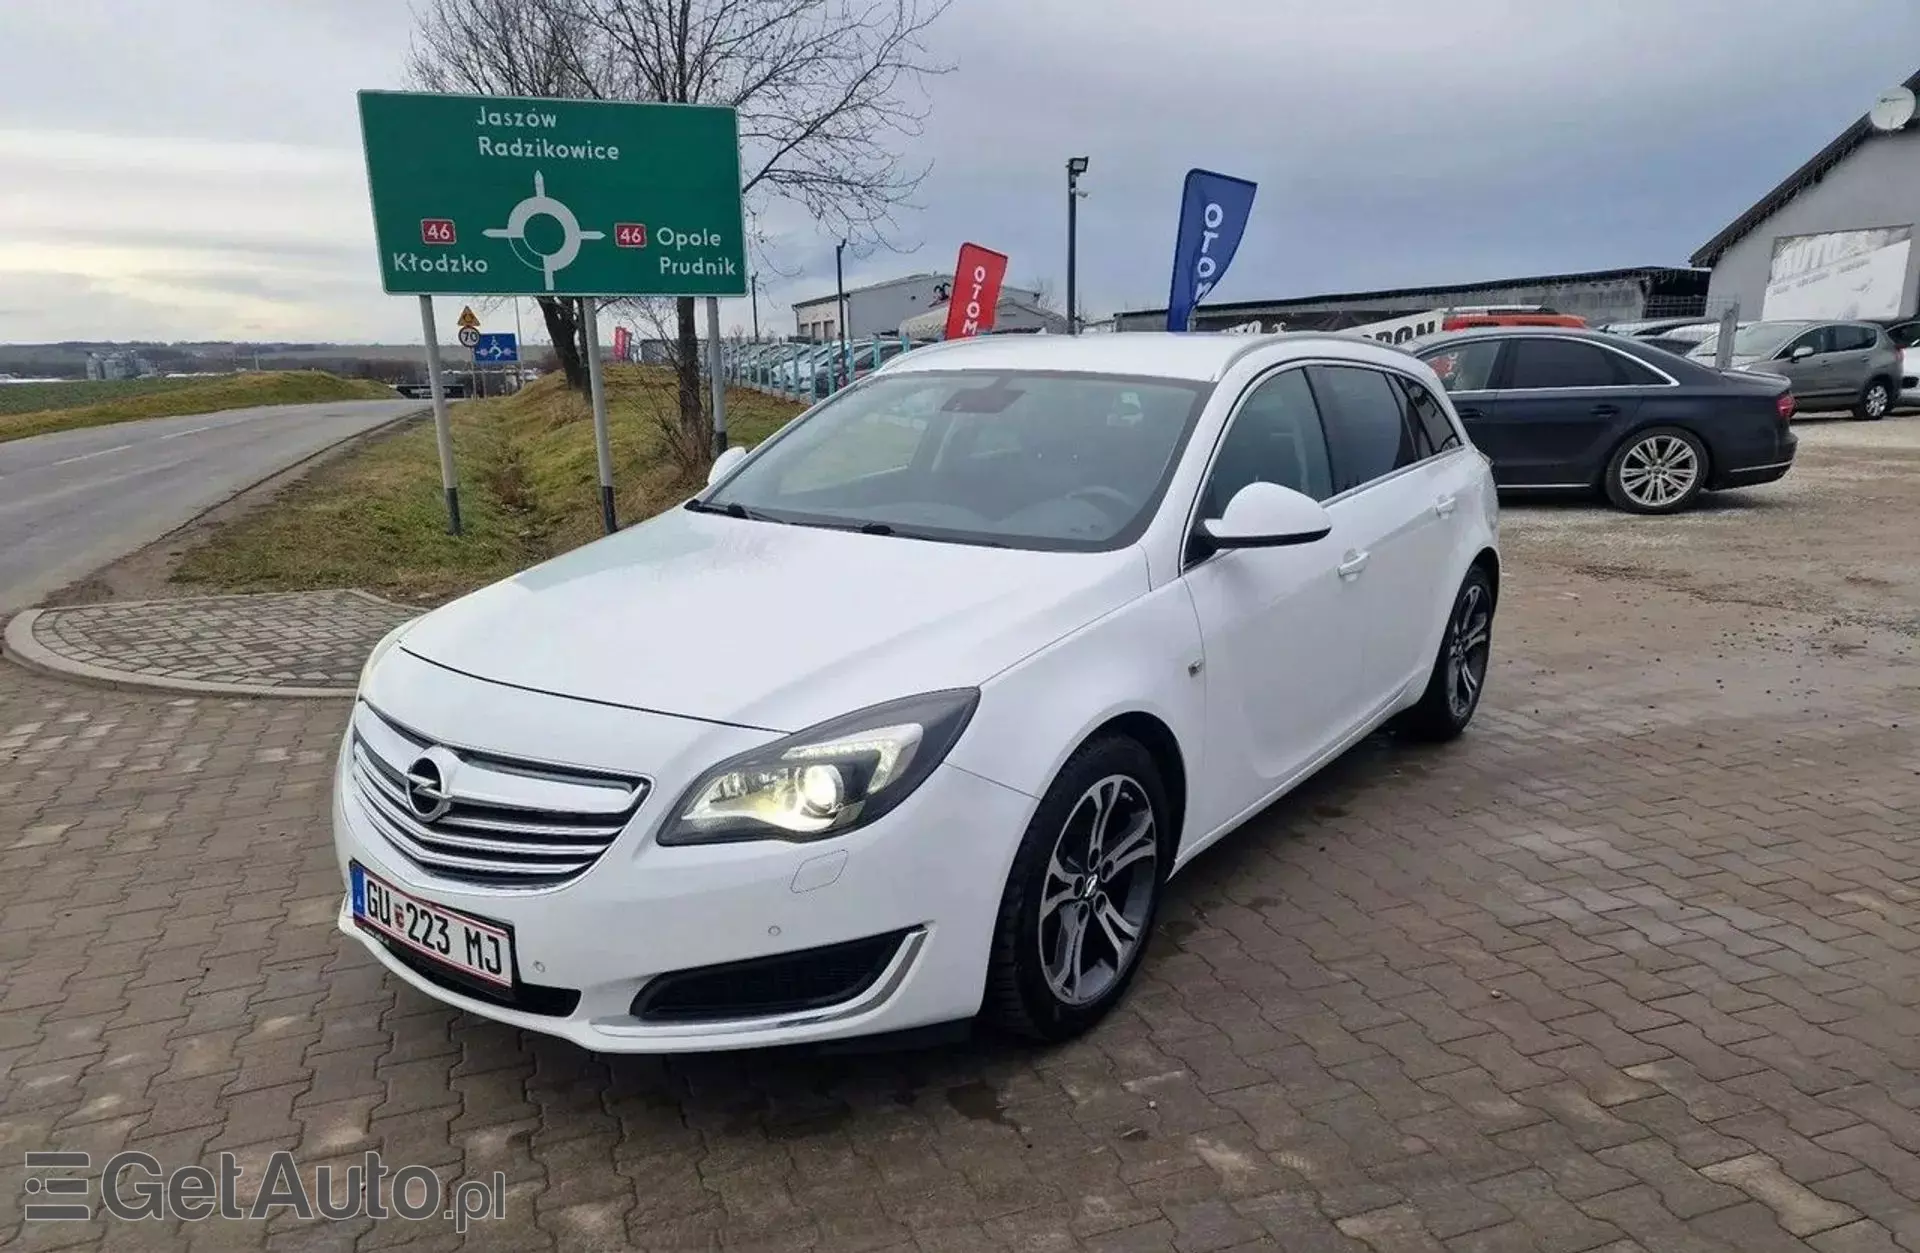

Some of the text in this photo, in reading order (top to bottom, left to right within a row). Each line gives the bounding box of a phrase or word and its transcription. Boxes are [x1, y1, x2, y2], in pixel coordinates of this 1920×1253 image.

[476, 107, 557, 128] Jaszów
[478, 136, 620, 160] Radzikowice
[427, 223, 451, 240] 46
[619, 228, 642, 244] 46
[656, 227, 722, 251] Opole
[393, 252, 489, 273] Kłodzko
[659, 257, 737, 276] Prudnik
[462, 331, 477, 342] 70
[366, 879, 391, 928] GU
[406, 902, 450, 955] 223
[464, 926, 502, 975] MJ
